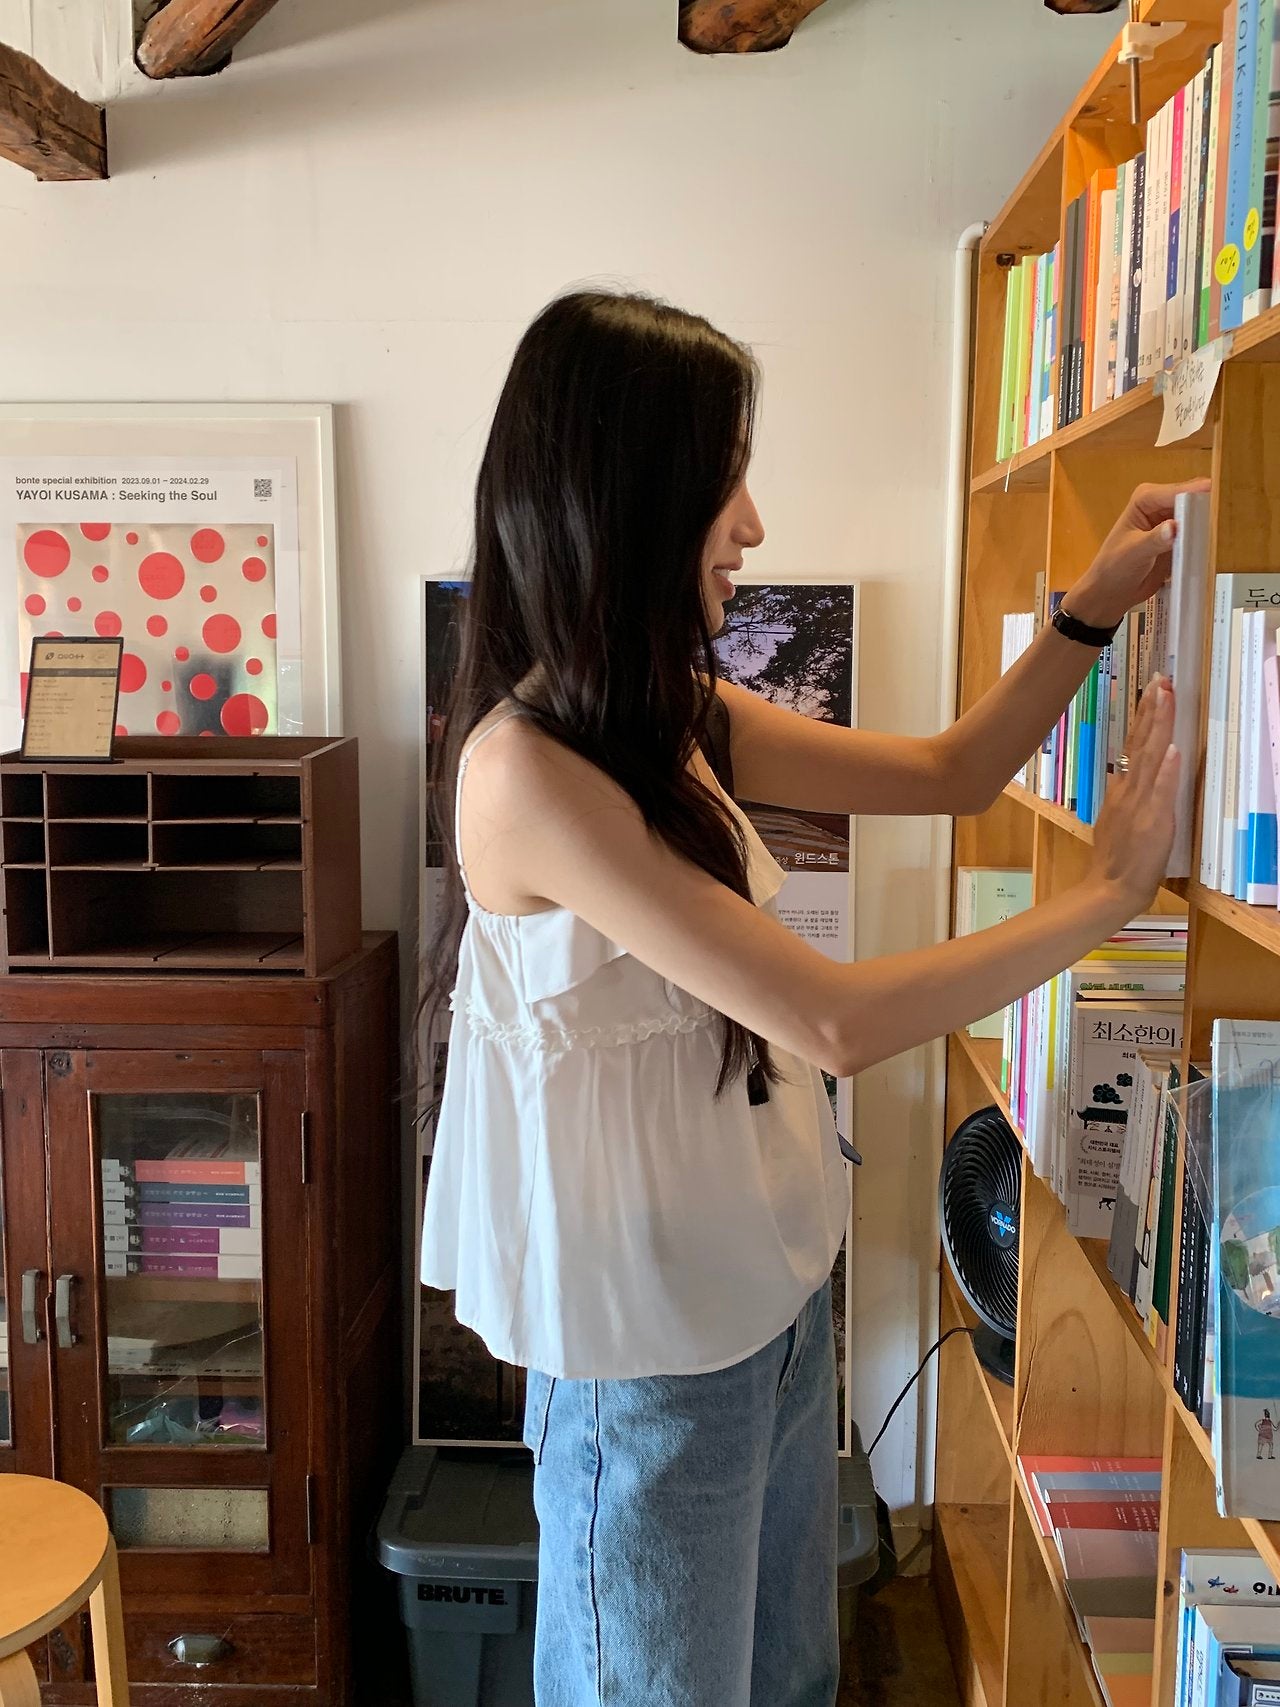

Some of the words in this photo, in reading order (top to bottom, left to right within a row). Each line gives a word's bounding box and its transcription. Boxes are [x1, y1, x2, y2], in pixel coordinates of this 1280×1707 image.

[1236, 2, 1249, 81] FOLK
[1234, 91, 1244, 152] TRAVEL
[15, 476, 40, 485] bonte
[42, 476, 73, 486] special
[74, 476, 117, 485] exhibition
[121, 477, 161, 485] 2023.09.01
[169, 477, 209, 485] 2024.02.29
[16, 490, 52, 500] YAYOI
[55, 490, 108, 500] KUSAMA
[119, 490, 166, 503] Seeking
[169, 490, 188, 501] the
[191, 490, 218, 501] Soul
[794, 852, 840, 866] 윈드스톤
[1092, 1021, 1176, 1048] 최소한의
[417, 1583, 505, 1605] BRUTE
